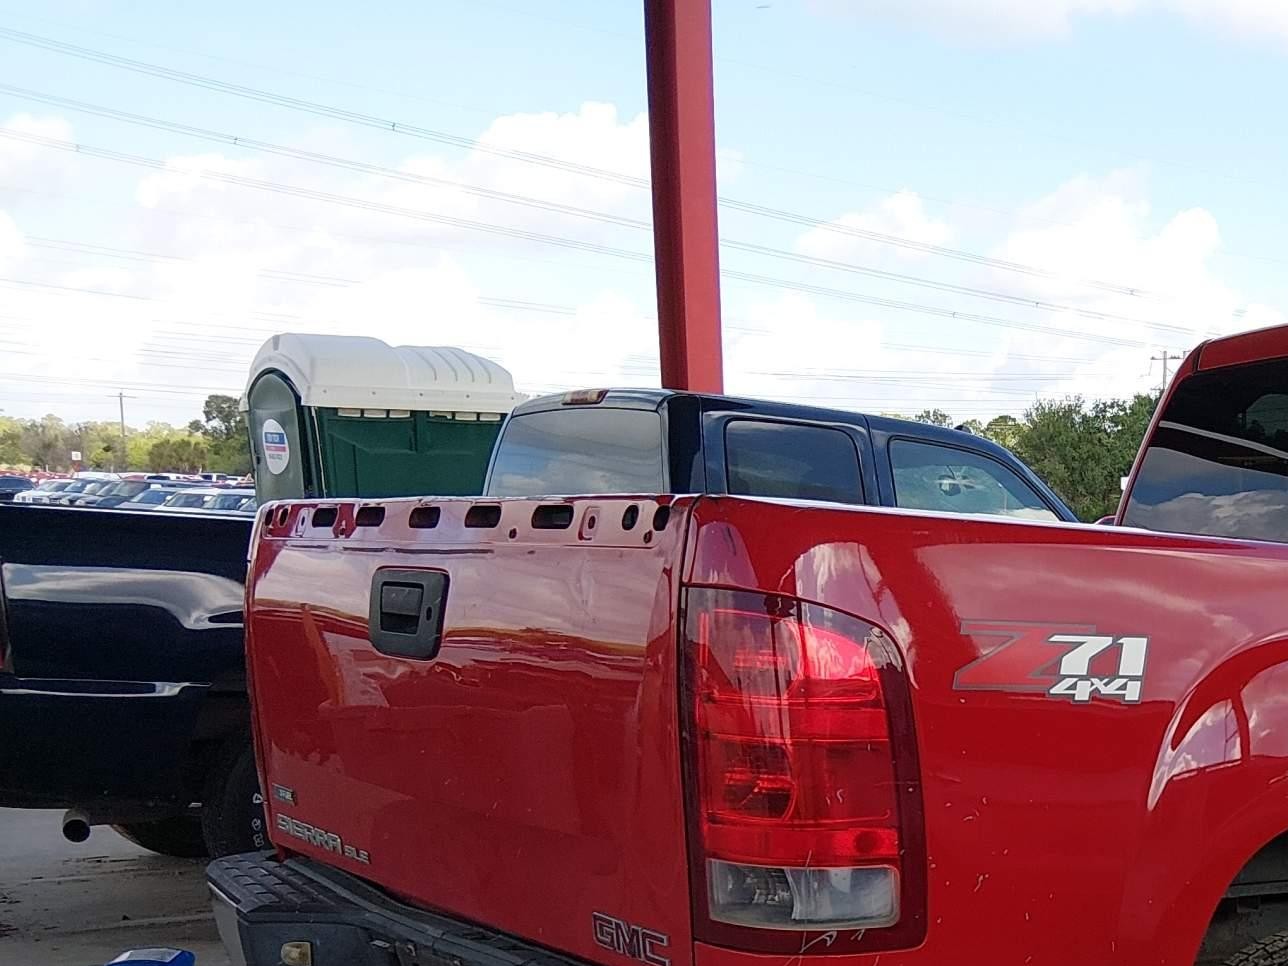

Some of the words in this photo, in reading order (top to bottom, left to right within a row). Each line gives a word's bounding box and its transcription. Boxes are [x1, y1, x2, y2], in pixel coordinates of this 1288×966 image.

[952, 619, 1150, 690] Z71
[276, 813, 342, 855] SIERRA
[344, 845, 370, 864] SLE
